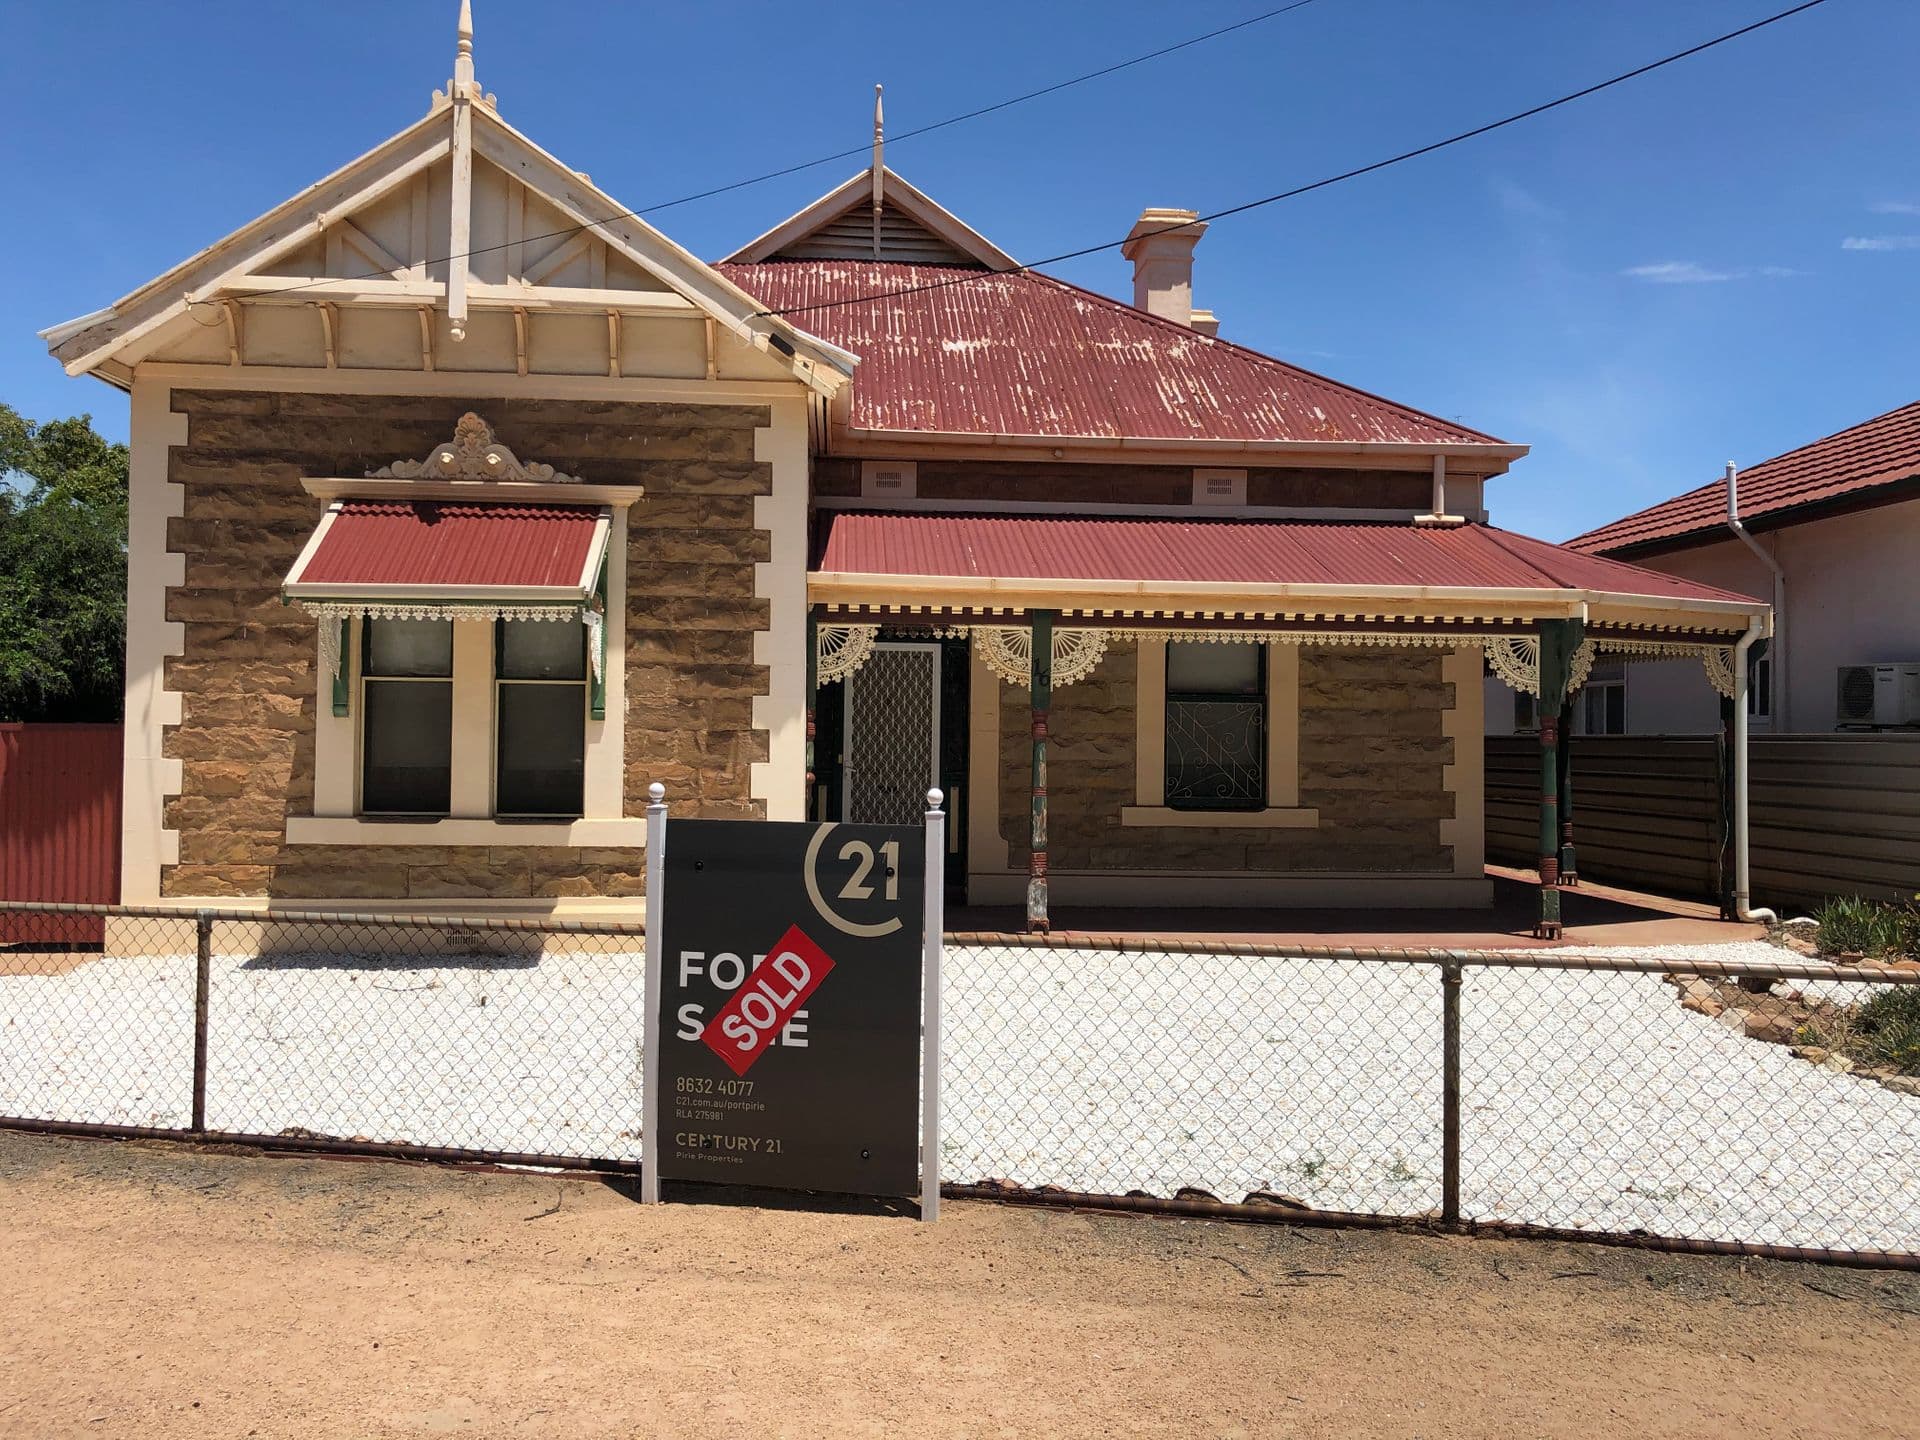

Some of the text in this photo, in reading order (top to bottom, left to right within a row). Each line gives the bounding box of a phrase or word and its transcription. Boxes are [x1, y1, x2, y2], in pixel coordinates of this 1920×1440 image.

[679, 951, 768, 990] FO
[722, 951, 811, 1051] SOLD
[676, 1003, 809, 1047] SE
[676, 1076, 754, 1097] 8632 4077
[675, 1108, 724, 1121] RLA 275981
[675, 1132, 761, 1152] CENTURY
[676, 1152, 744, 1164] Pirie Properties
